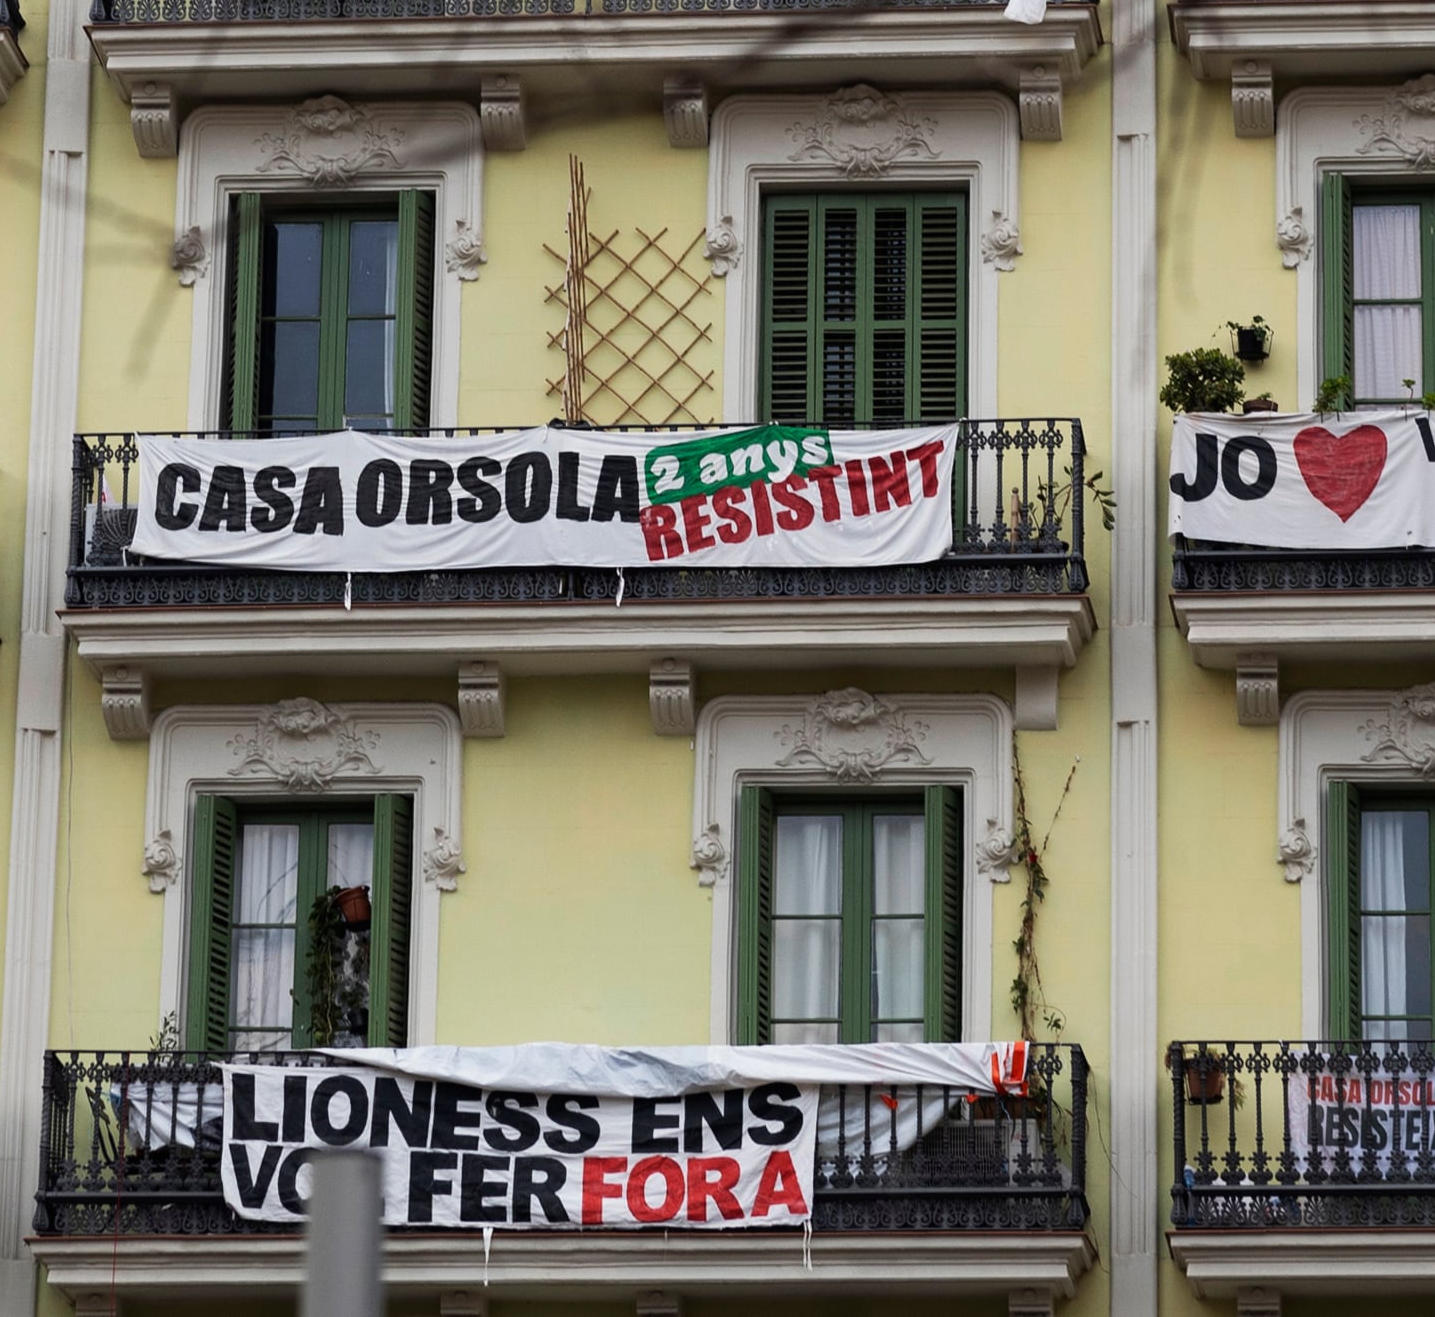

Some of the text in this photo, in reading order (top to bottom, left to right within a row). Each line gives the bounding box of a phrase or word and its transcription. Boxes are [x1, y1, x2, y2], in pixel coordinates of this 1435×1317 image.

[154, 451, 641, 536] CASA ORSOLA
[640, 440, 944, 562] RESISTINT
[650, 435, 830, 494] 2 anys
[1169, 433, 1277, 502] JO
[231, 1073, 804, 1155] LIONESS ENS
[407, 1150, 568, 1223] FER
[581, 1150, 809, 1225] FORA
